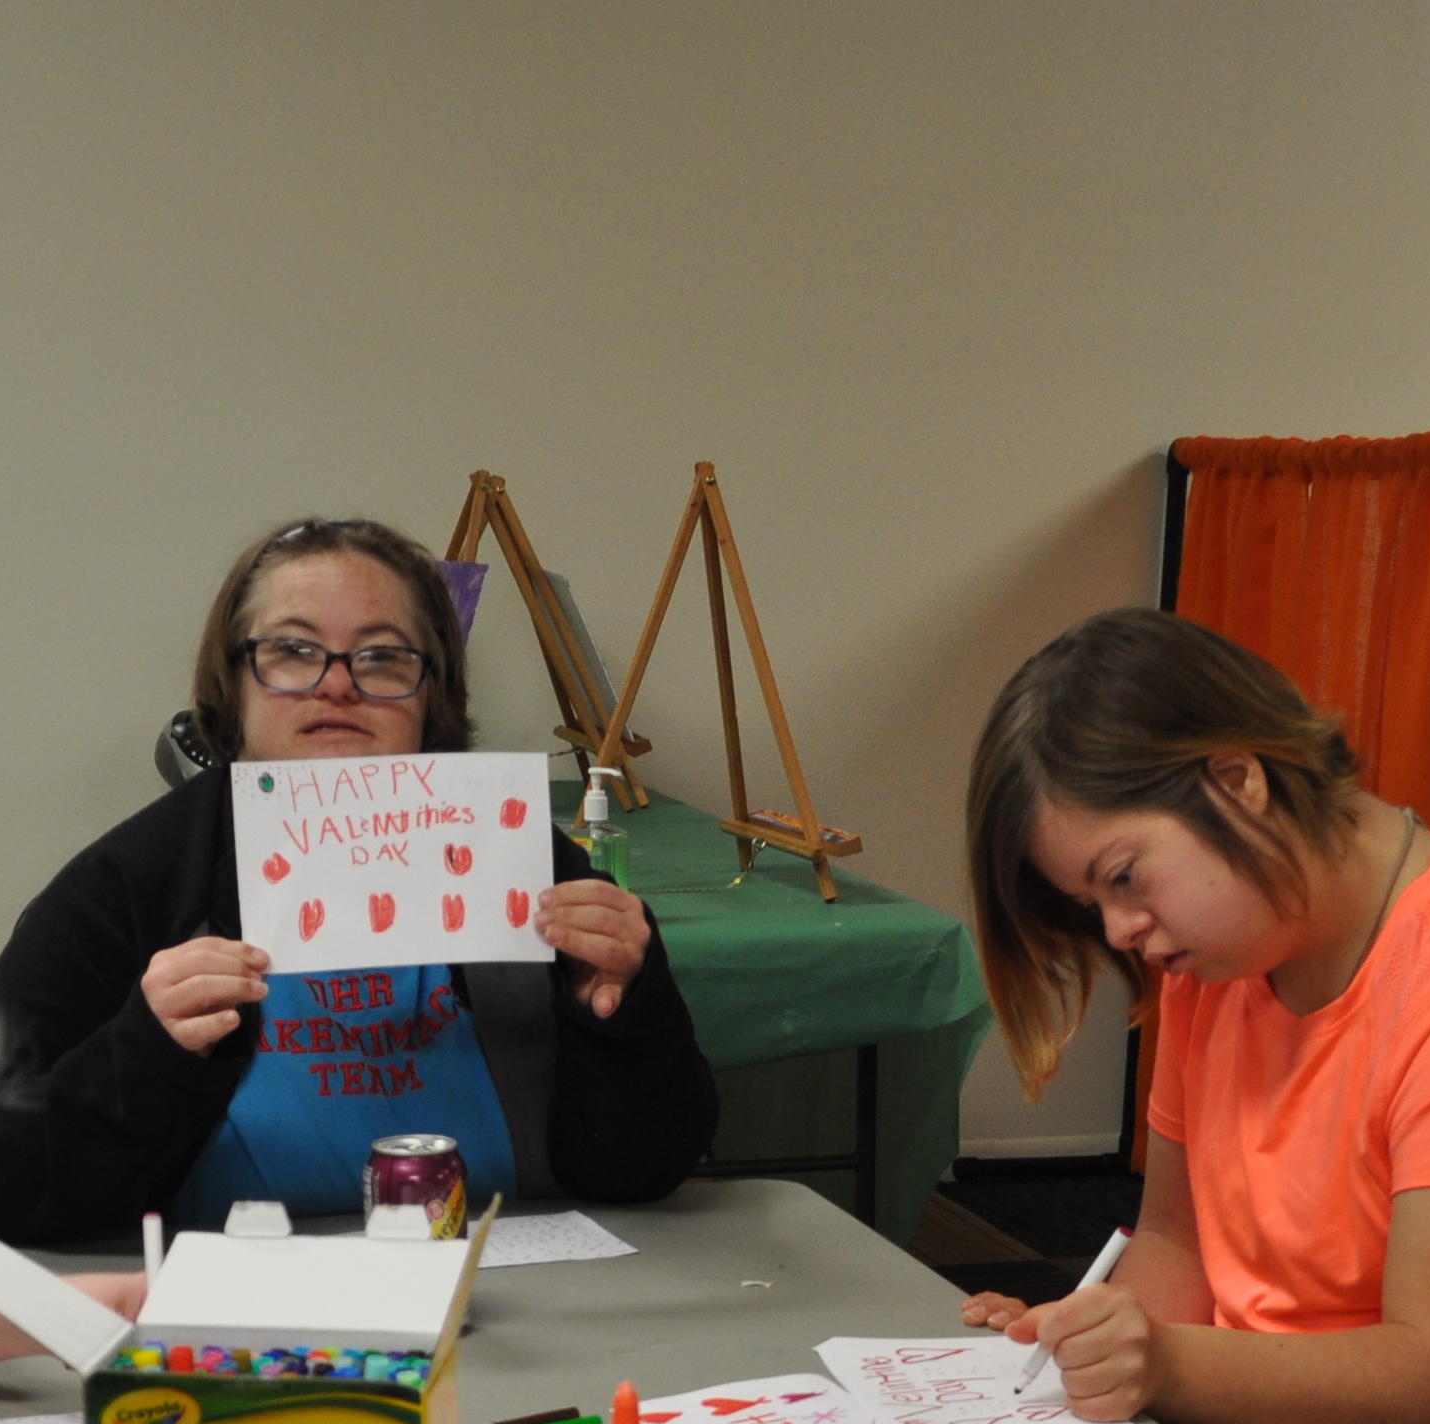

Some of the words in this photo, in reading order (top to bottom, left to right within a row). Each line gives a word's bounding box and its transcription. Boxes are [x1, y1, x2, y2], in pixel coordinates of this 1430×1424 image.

[287, 760, 436, 812] HAPPY
[351, 840, 409, 867] DAY
[310, 1058, 425, 1097] TEAM
[116, 1401, 181, 1423] Crayola
